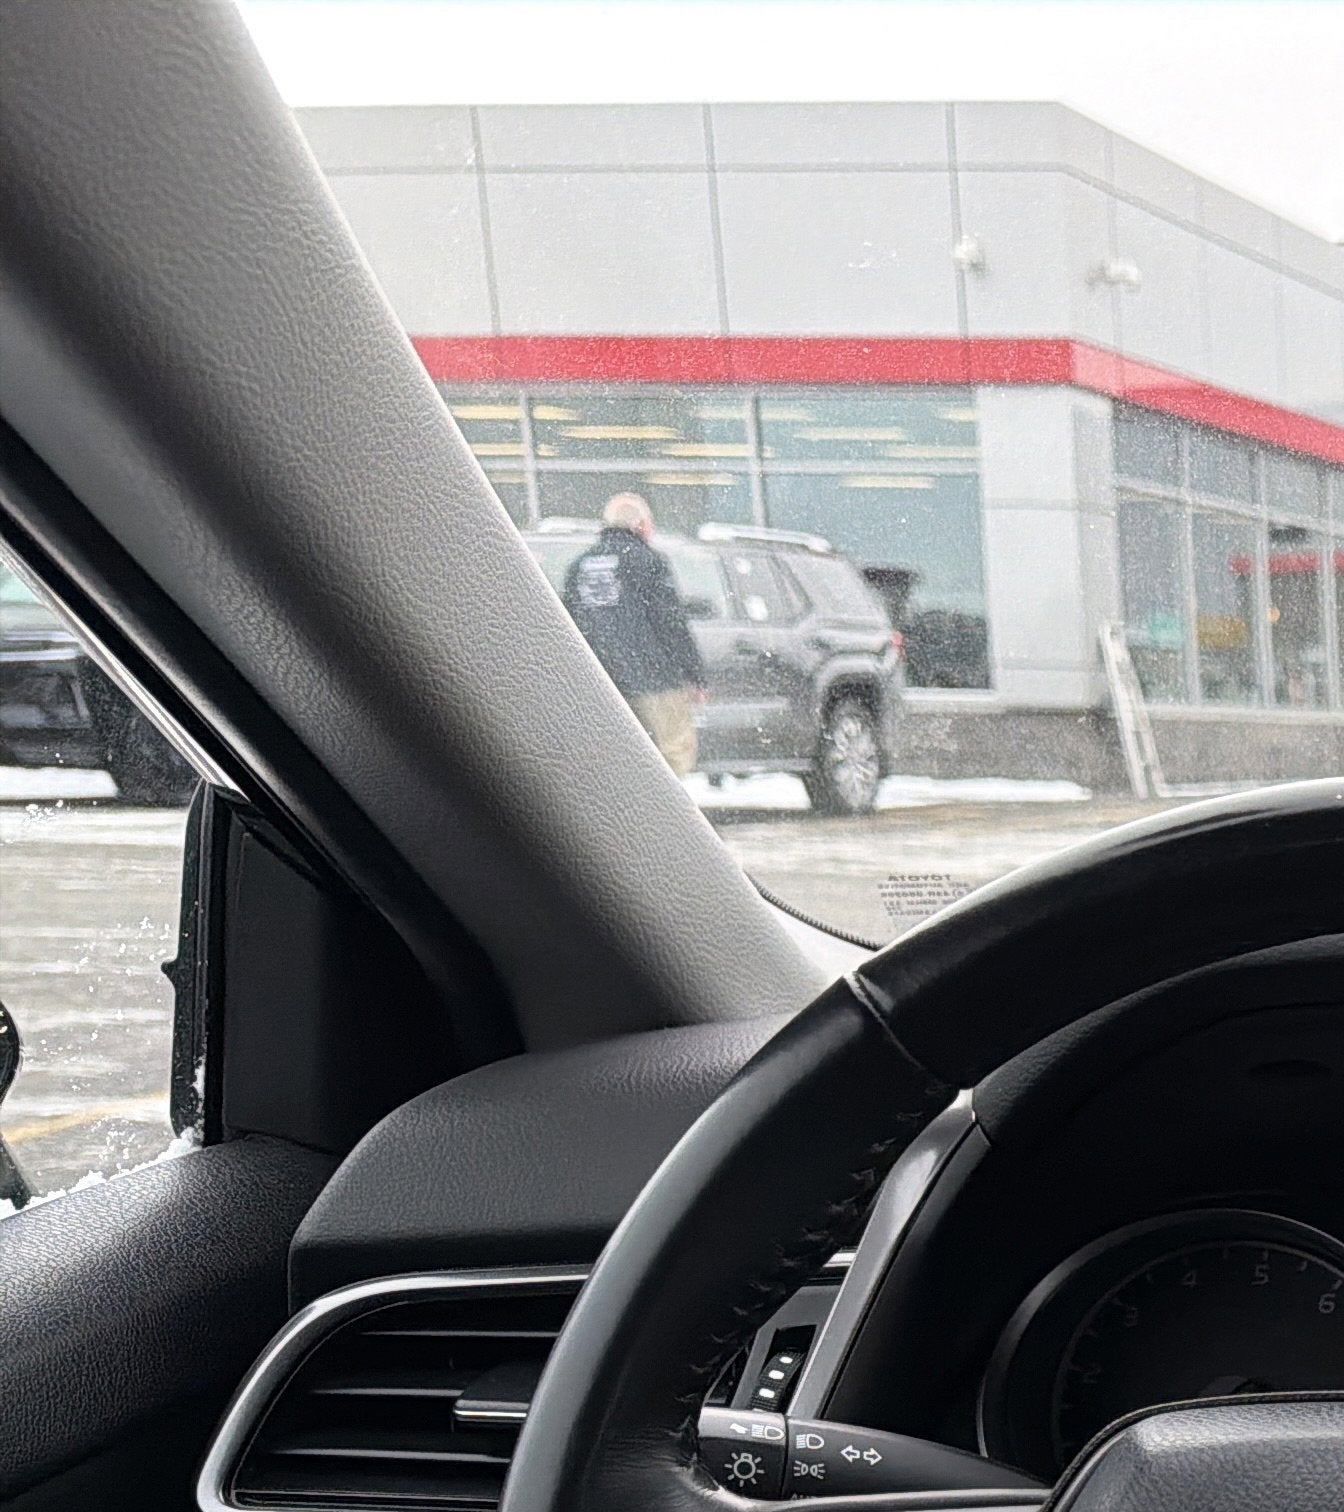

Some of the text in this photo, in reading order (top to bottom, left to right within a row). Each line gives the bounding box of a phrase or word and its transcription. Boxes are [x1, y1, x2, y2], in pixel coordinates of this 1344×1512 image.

[1181, 1269, 1198, 1288] 4
[1251, 1265, 1270, 1286] 5
[1318, 1293, 1336, 1314] 6
